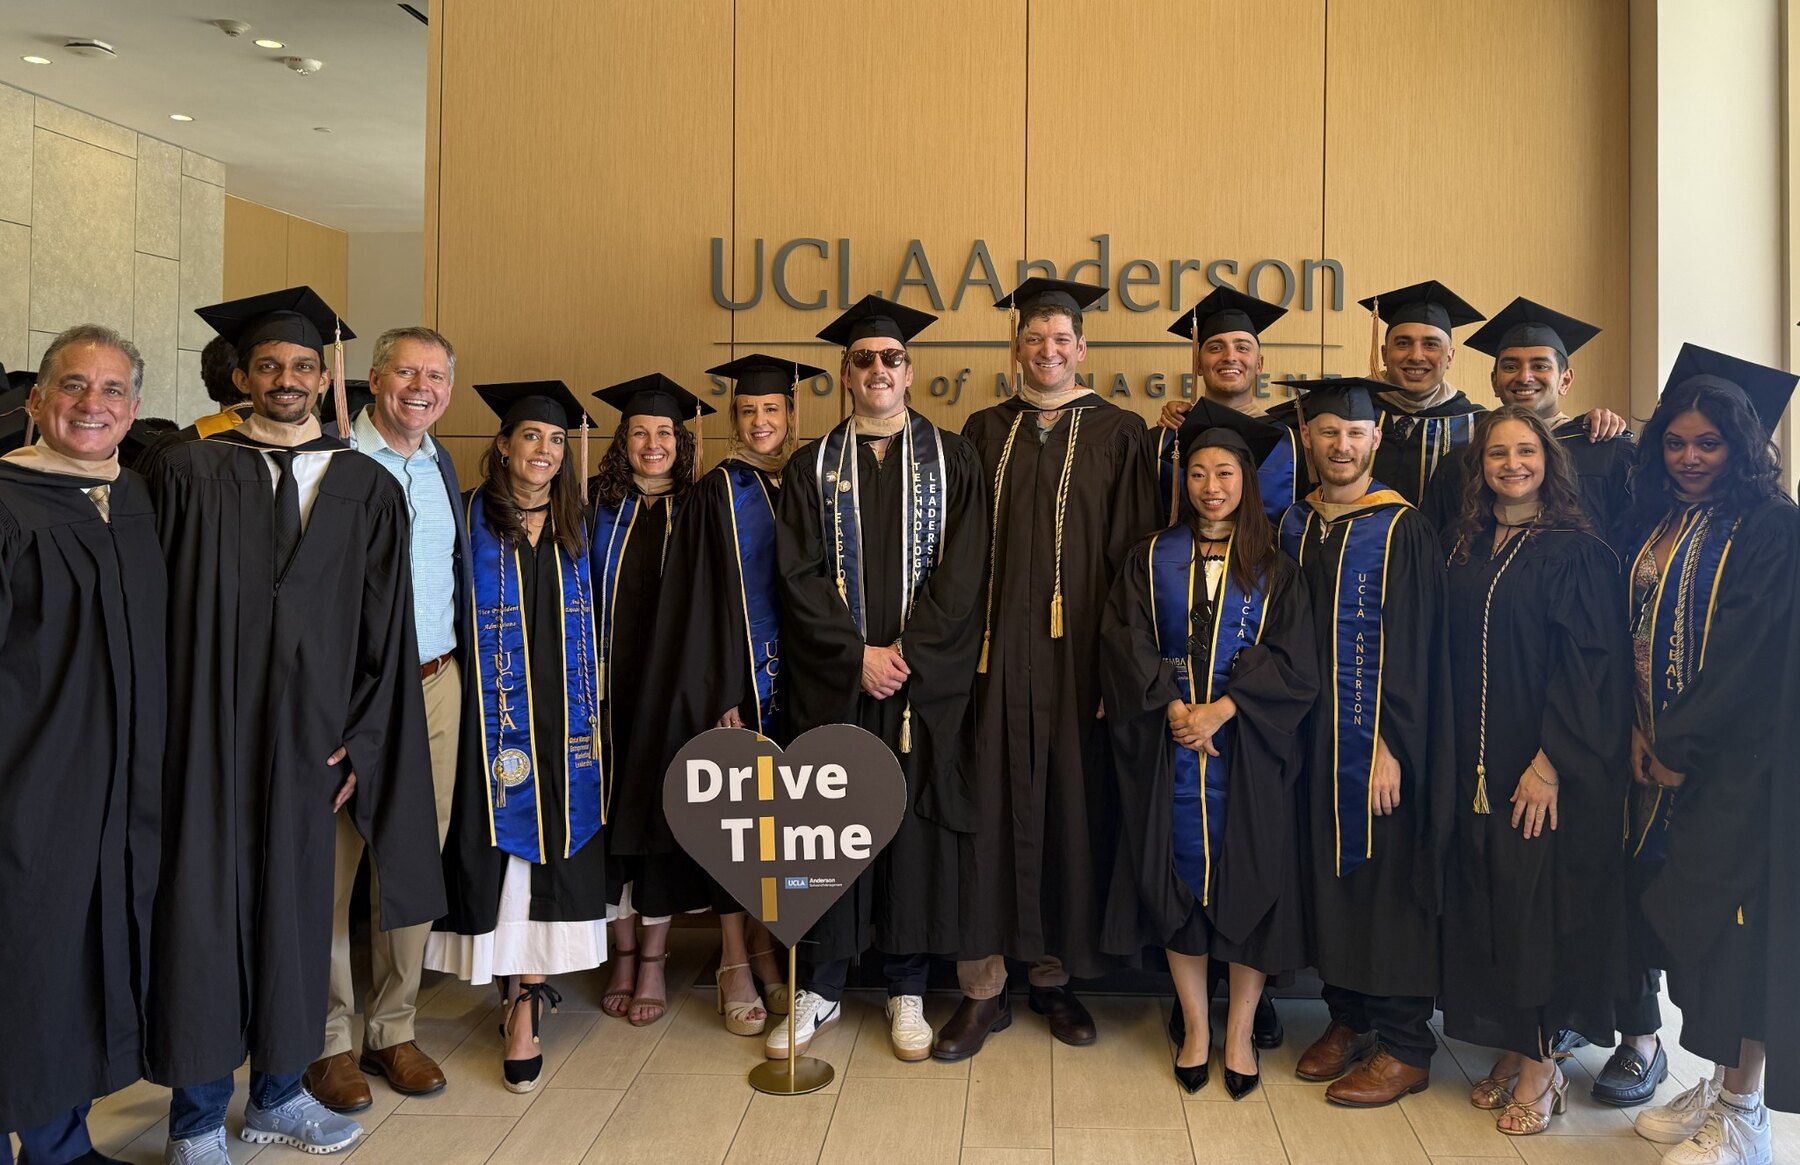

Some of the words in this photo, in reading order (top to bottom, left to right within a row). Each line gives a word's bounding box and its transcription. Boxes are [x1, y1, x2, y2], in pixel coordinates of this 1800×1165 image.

[930, 368, 970, 405] of
[914, 462, 922, 580] TECHNOLOGY
[927, 472, 936, 577] LEADERSHI
[1237, 595, 1251, 638] UCLA
[1357, 573, 1366, 618] UCLA
[492, 651, 517, 732] UCLA
[577, 640, 586, 716] BRUINS
[765, 639, 780, 715] UCLA
[1354, 632, 1364, 725] ANDERSON
[788, 879, 805, 887] UCLA
